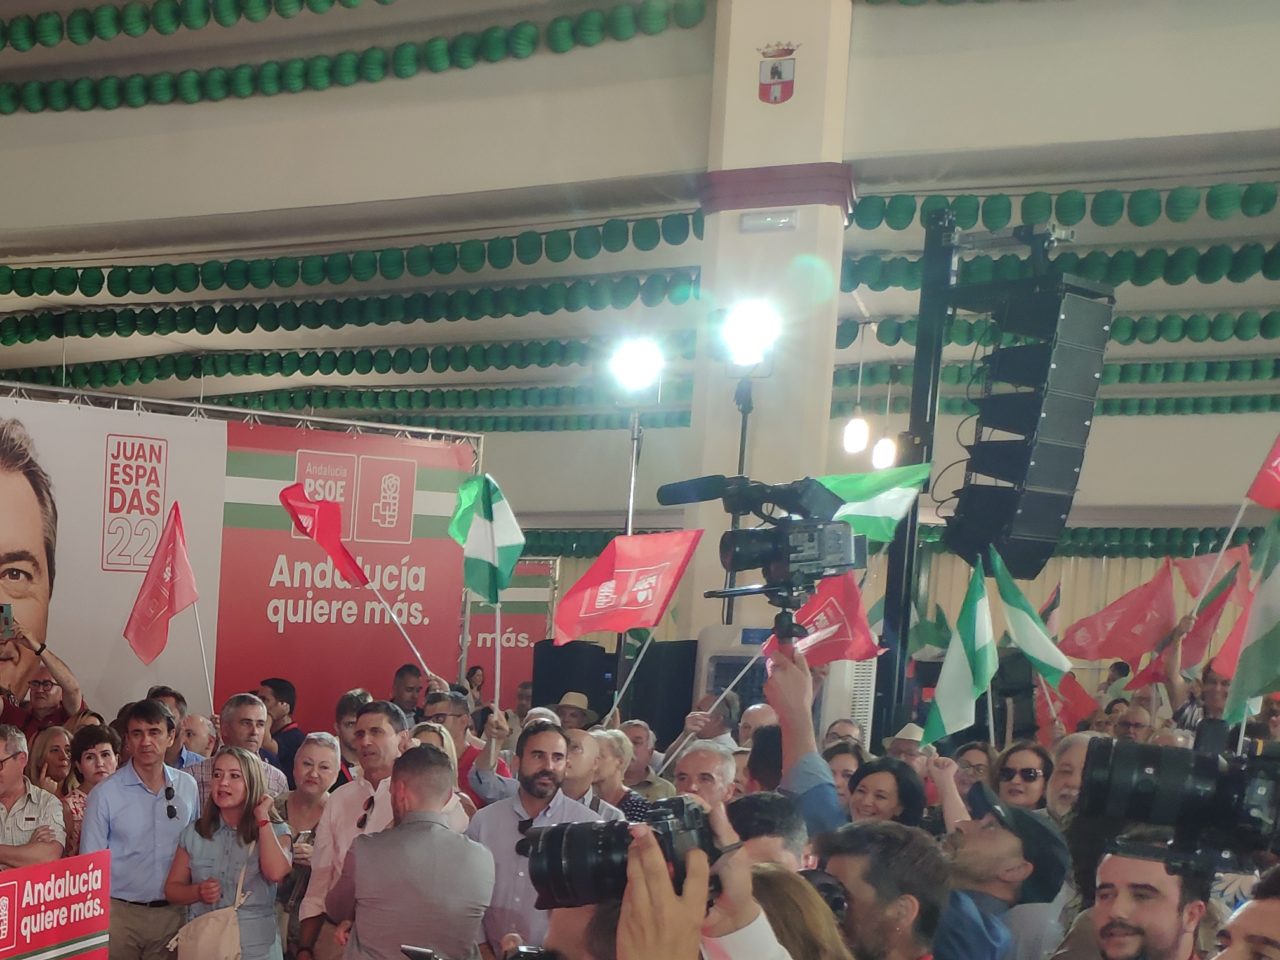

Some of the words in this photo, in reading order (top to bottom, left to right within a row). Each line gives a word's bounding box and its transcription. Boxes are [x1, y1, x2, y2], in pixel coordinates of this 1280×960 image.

[111, 441, 162, 464] JUAN
[110, 463, 160, 488] ESPA
[109, 487, 160, 516] DAS
[305, 479, 346, 502] PSOE
[106, 517, 159, 566] 22
[267, 591, 358, 633] quiere
[364, 592, 430, 625] más.
[477, 627, 535, 648] más.
[21, 862, 103, 908] Andalucía
[21, 905, 68, 944] quiere
[70, 893, 104, 923] más.
